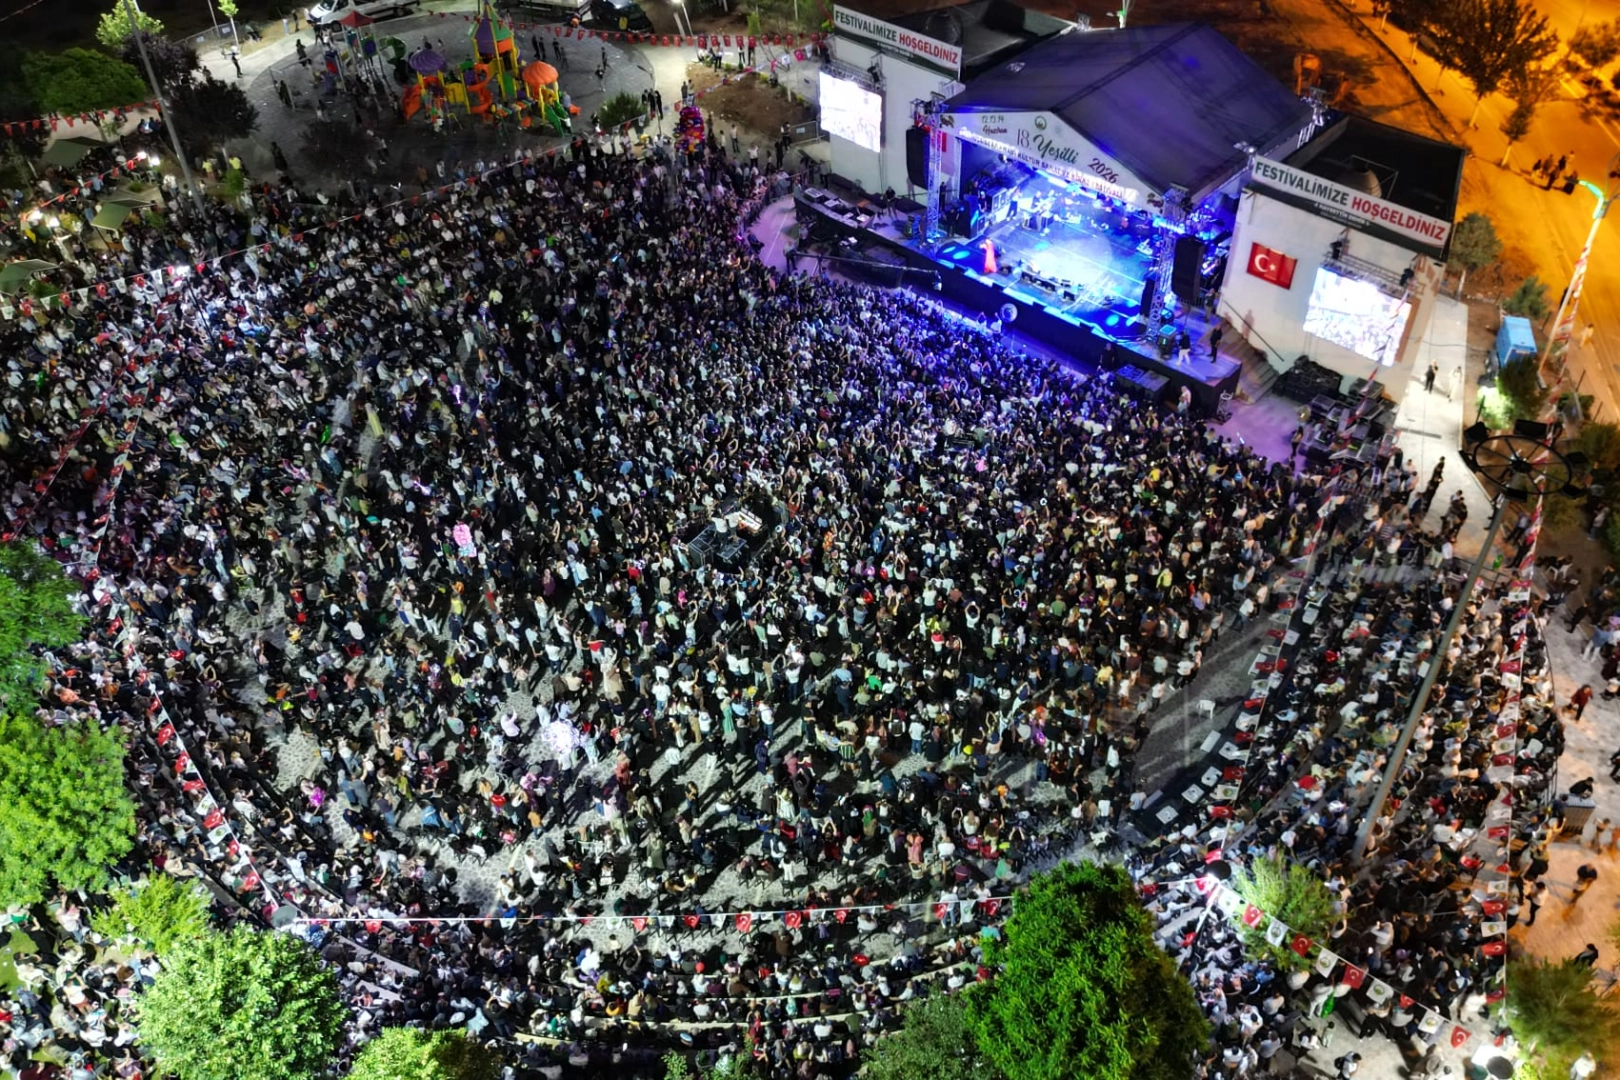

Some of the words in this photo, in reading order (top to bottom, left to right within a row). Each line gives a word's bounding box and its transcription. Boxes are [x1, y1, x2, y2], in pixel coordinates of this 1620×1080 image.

[835, 10, 897, 42] FESTİVALİMİZE
[899, 32, 958, 64] HOŞGELDİNİZ
[1033, 134, 1079, 164] Yeşilli
[1088, 157, 1119, 184] 2026
[1255, 161, 1349, 206] FESTİVALİMİZE
[1351, 196, 1446, 240] HOŞGELDİNİZ
